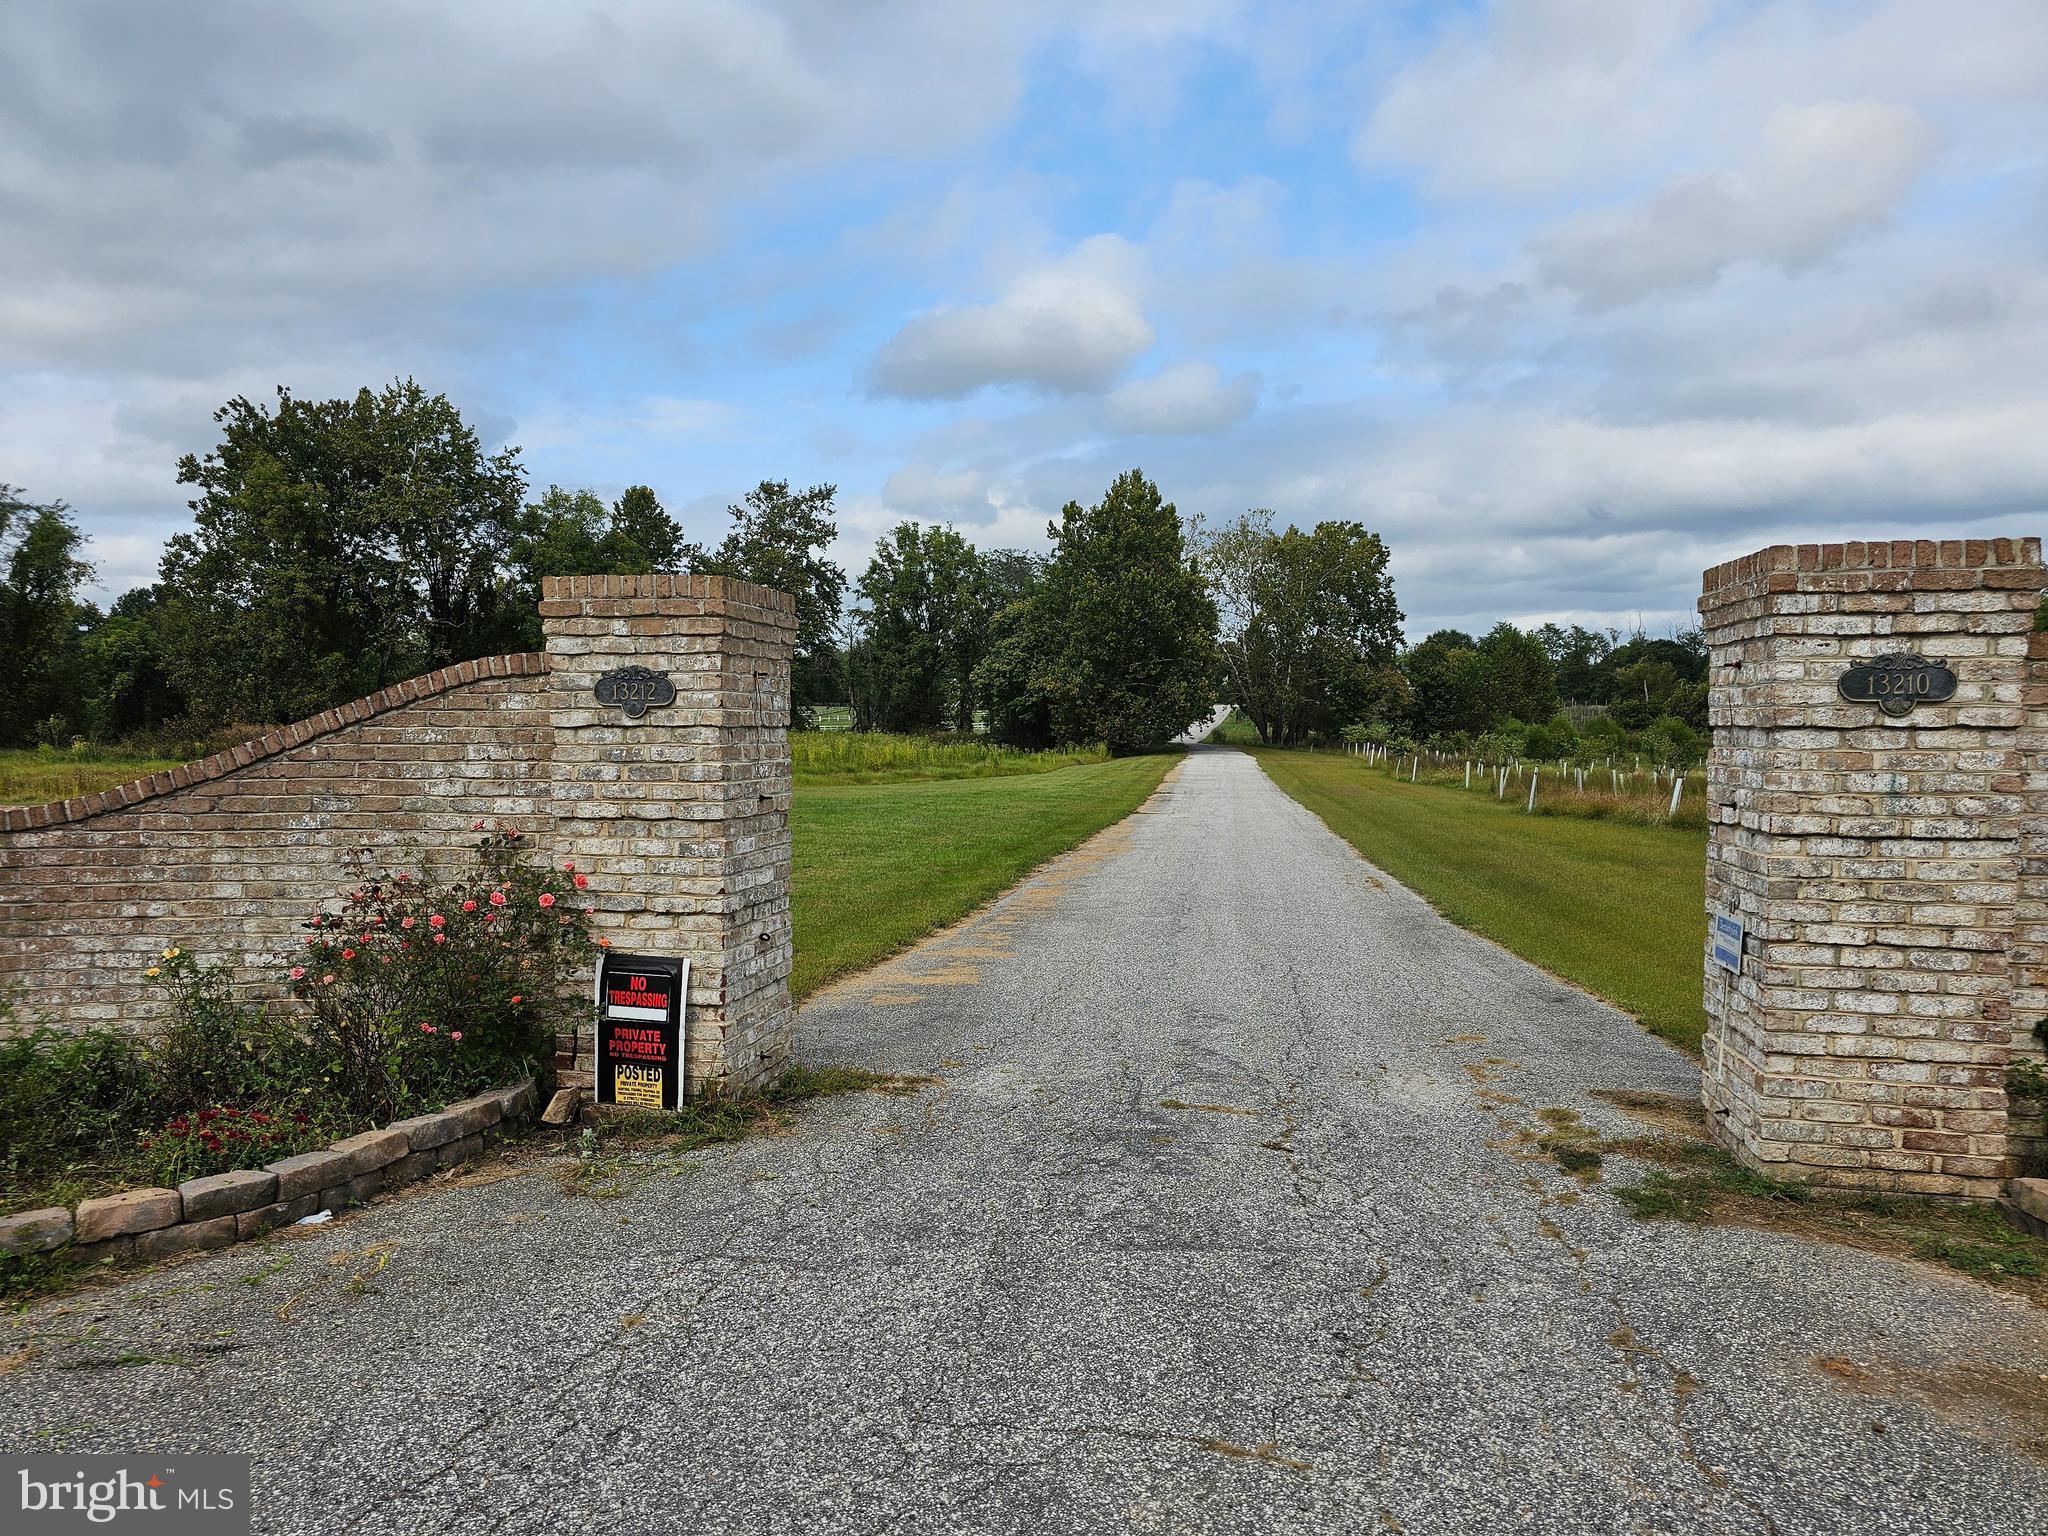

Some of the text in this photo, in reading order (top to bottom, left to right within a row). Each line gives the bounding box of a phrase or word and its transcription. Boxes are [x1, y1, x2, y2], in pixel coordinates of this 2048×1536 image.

[613, 682, 656, 700] 13212
[1866, 673, 1930, 695] 13210
[630, 976, 647, 991] NO
[608, 990, 668, 1008] TRESPASSING
[614, 1028, 661, 1042] PRIVATE
[608, 1039, 667, 1055] PROPERTY
[621, 1052, 667, 1062] TRESPASSING
[617, 1064, 661, 1083] POSTED
[637, 1081, 658, 1089] PROPERTY
